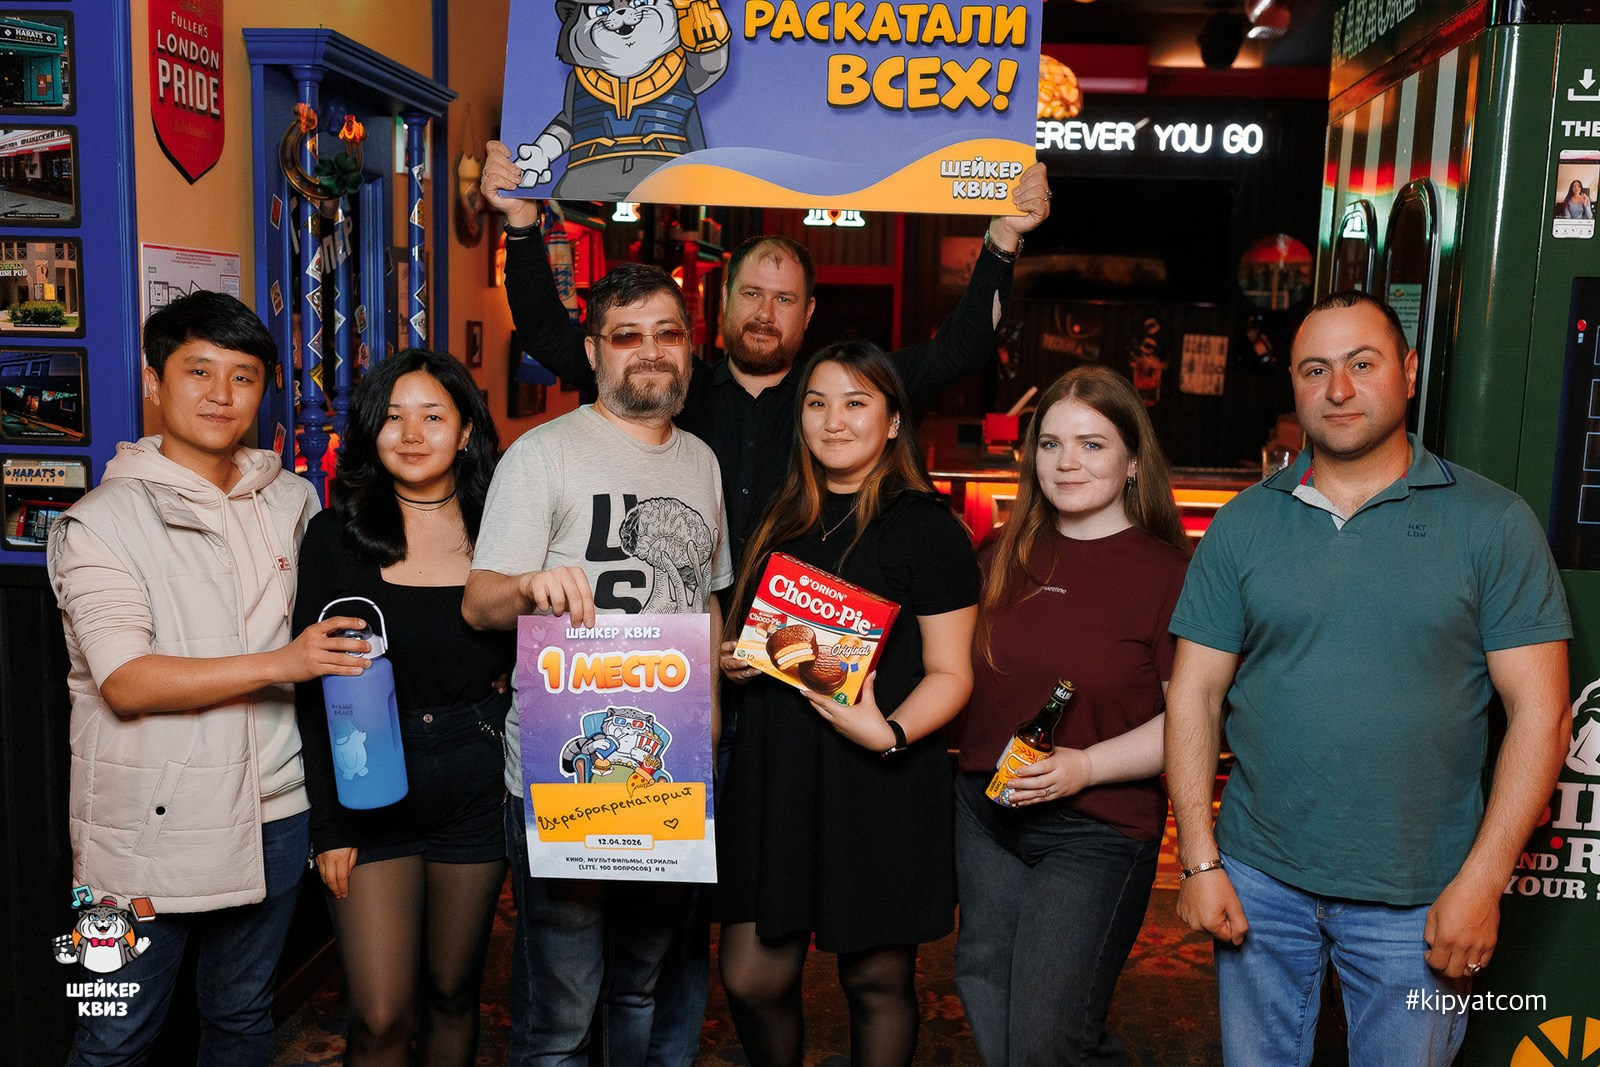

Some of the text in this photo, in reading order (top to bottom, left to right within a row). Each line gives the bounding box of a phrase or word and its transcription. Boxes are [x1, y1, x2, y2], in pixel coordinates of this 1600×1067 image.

[171, 10, 209, 38] FULLER'S
[743, 0, 1027, 47] РАСКАТАЛИ
[157, 28, 219, 70] LONDON
[157, 57, 220, 118] PRIDE
[826, 54, 1019, 113] ВСЕХ!
[1036, 121, 1264, 154] EREVER YOU GO
[940, 157, 1023, 180] ШЕЙКЕР
[952, 180, 1008, 200] КВИЗ
[1407, 530, 1427, 538] LDN
[1408, 523, 1428, 531] HKT
[624, 626, 661, 639] КВИЗ
[831, 643, 871, 659] Original
[541, 650, 688, 690] 1 МЕСТО
[597, 837, 643, 847] 12.04.2026
[1516, 852, 1559, 871] ND
